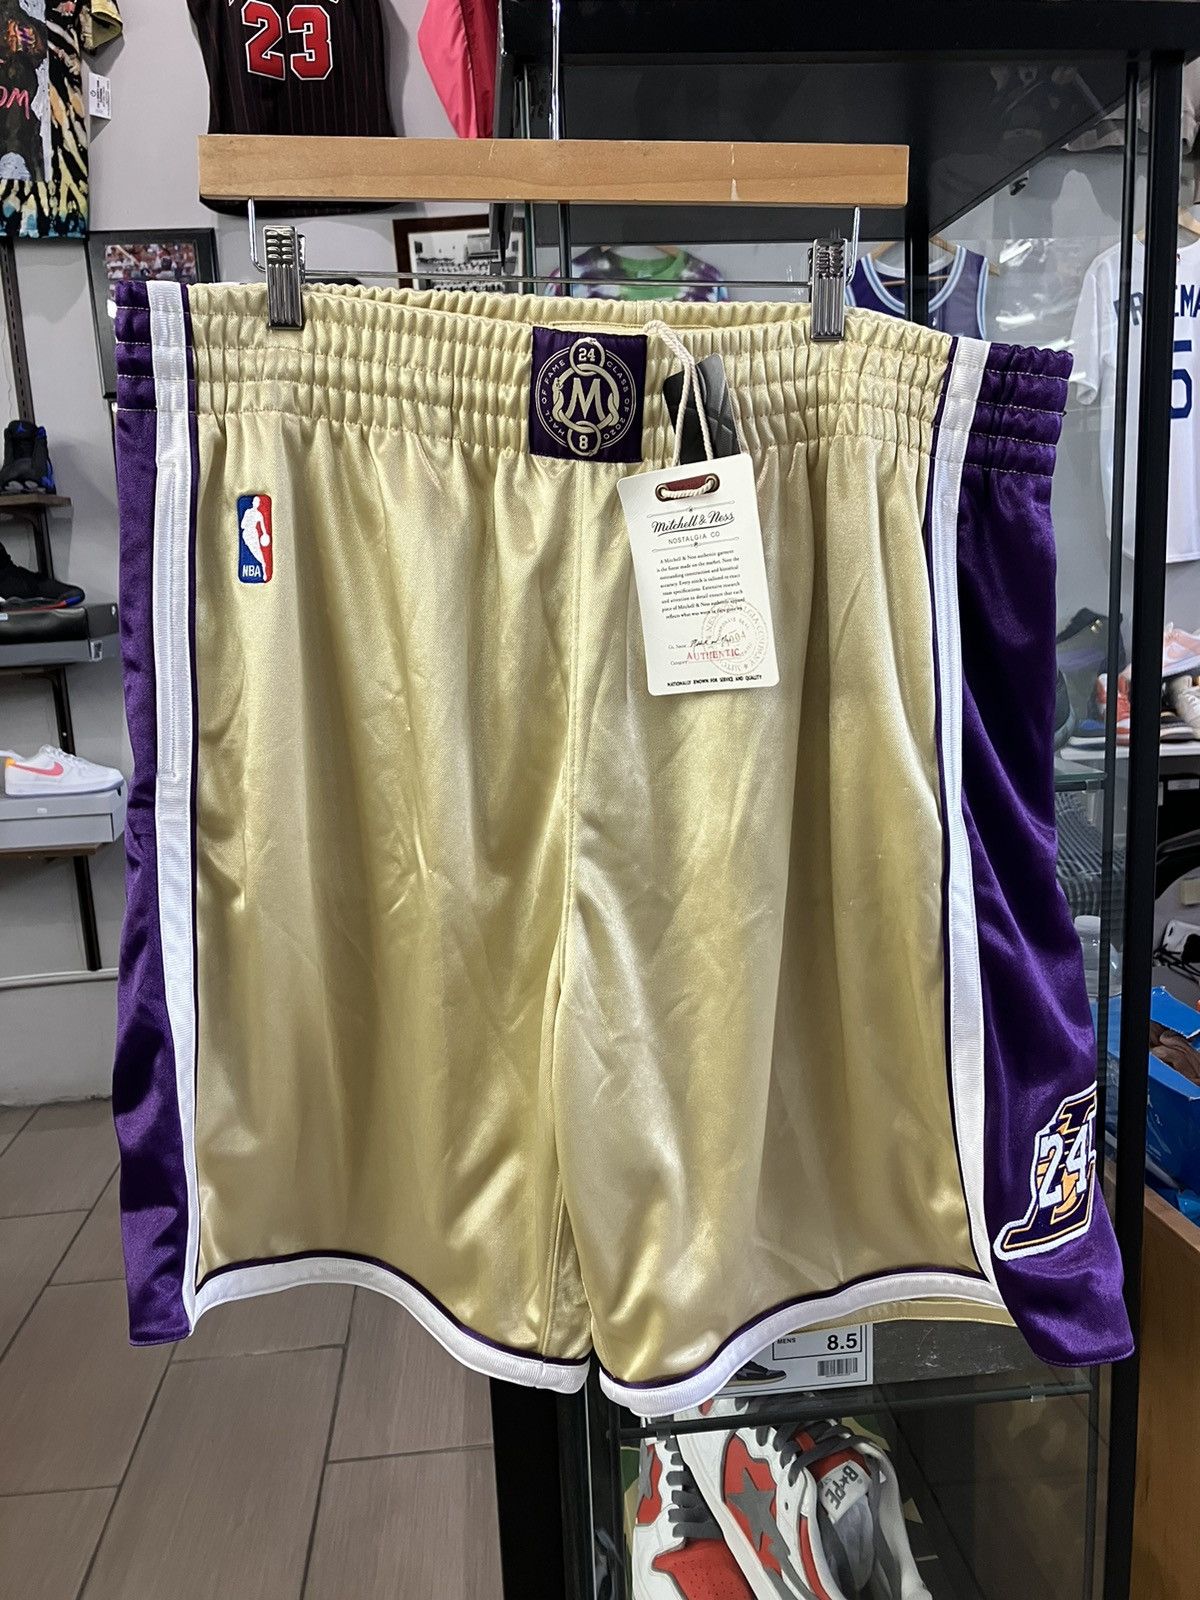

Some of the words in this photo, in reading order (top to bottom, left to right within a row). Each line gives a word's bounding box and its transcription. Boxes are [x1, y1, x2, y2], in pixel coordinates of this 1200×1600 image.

[241, 0, 333, 80] 23
[578, 348, 596, 362] 24
[544, 359, 566, 385] FAME
[606, 361, 629, 392] CLASS
[541, 390, 548, 404] OF
[564, 378, 606, 422] M
[624, 398, 630, 412] OF
[545, 410, 566, 436] HALL
[603, 417, 626, 440] 2020
[578, 435, 589, 450] 8
[651, 514, 698, 533] Mitchell
[698, 514, 706, 526] &
[708, 510, 734, 525] Ness
[668, 534, 707, 544] NOSTALGIA
[242, 564, 262, 578] NBA
[687, 648, 740, 660] AUTHENTIC
[1038, 1123, 1090, 1209] 24
[827, 1333, 858, 1351] 8.5
